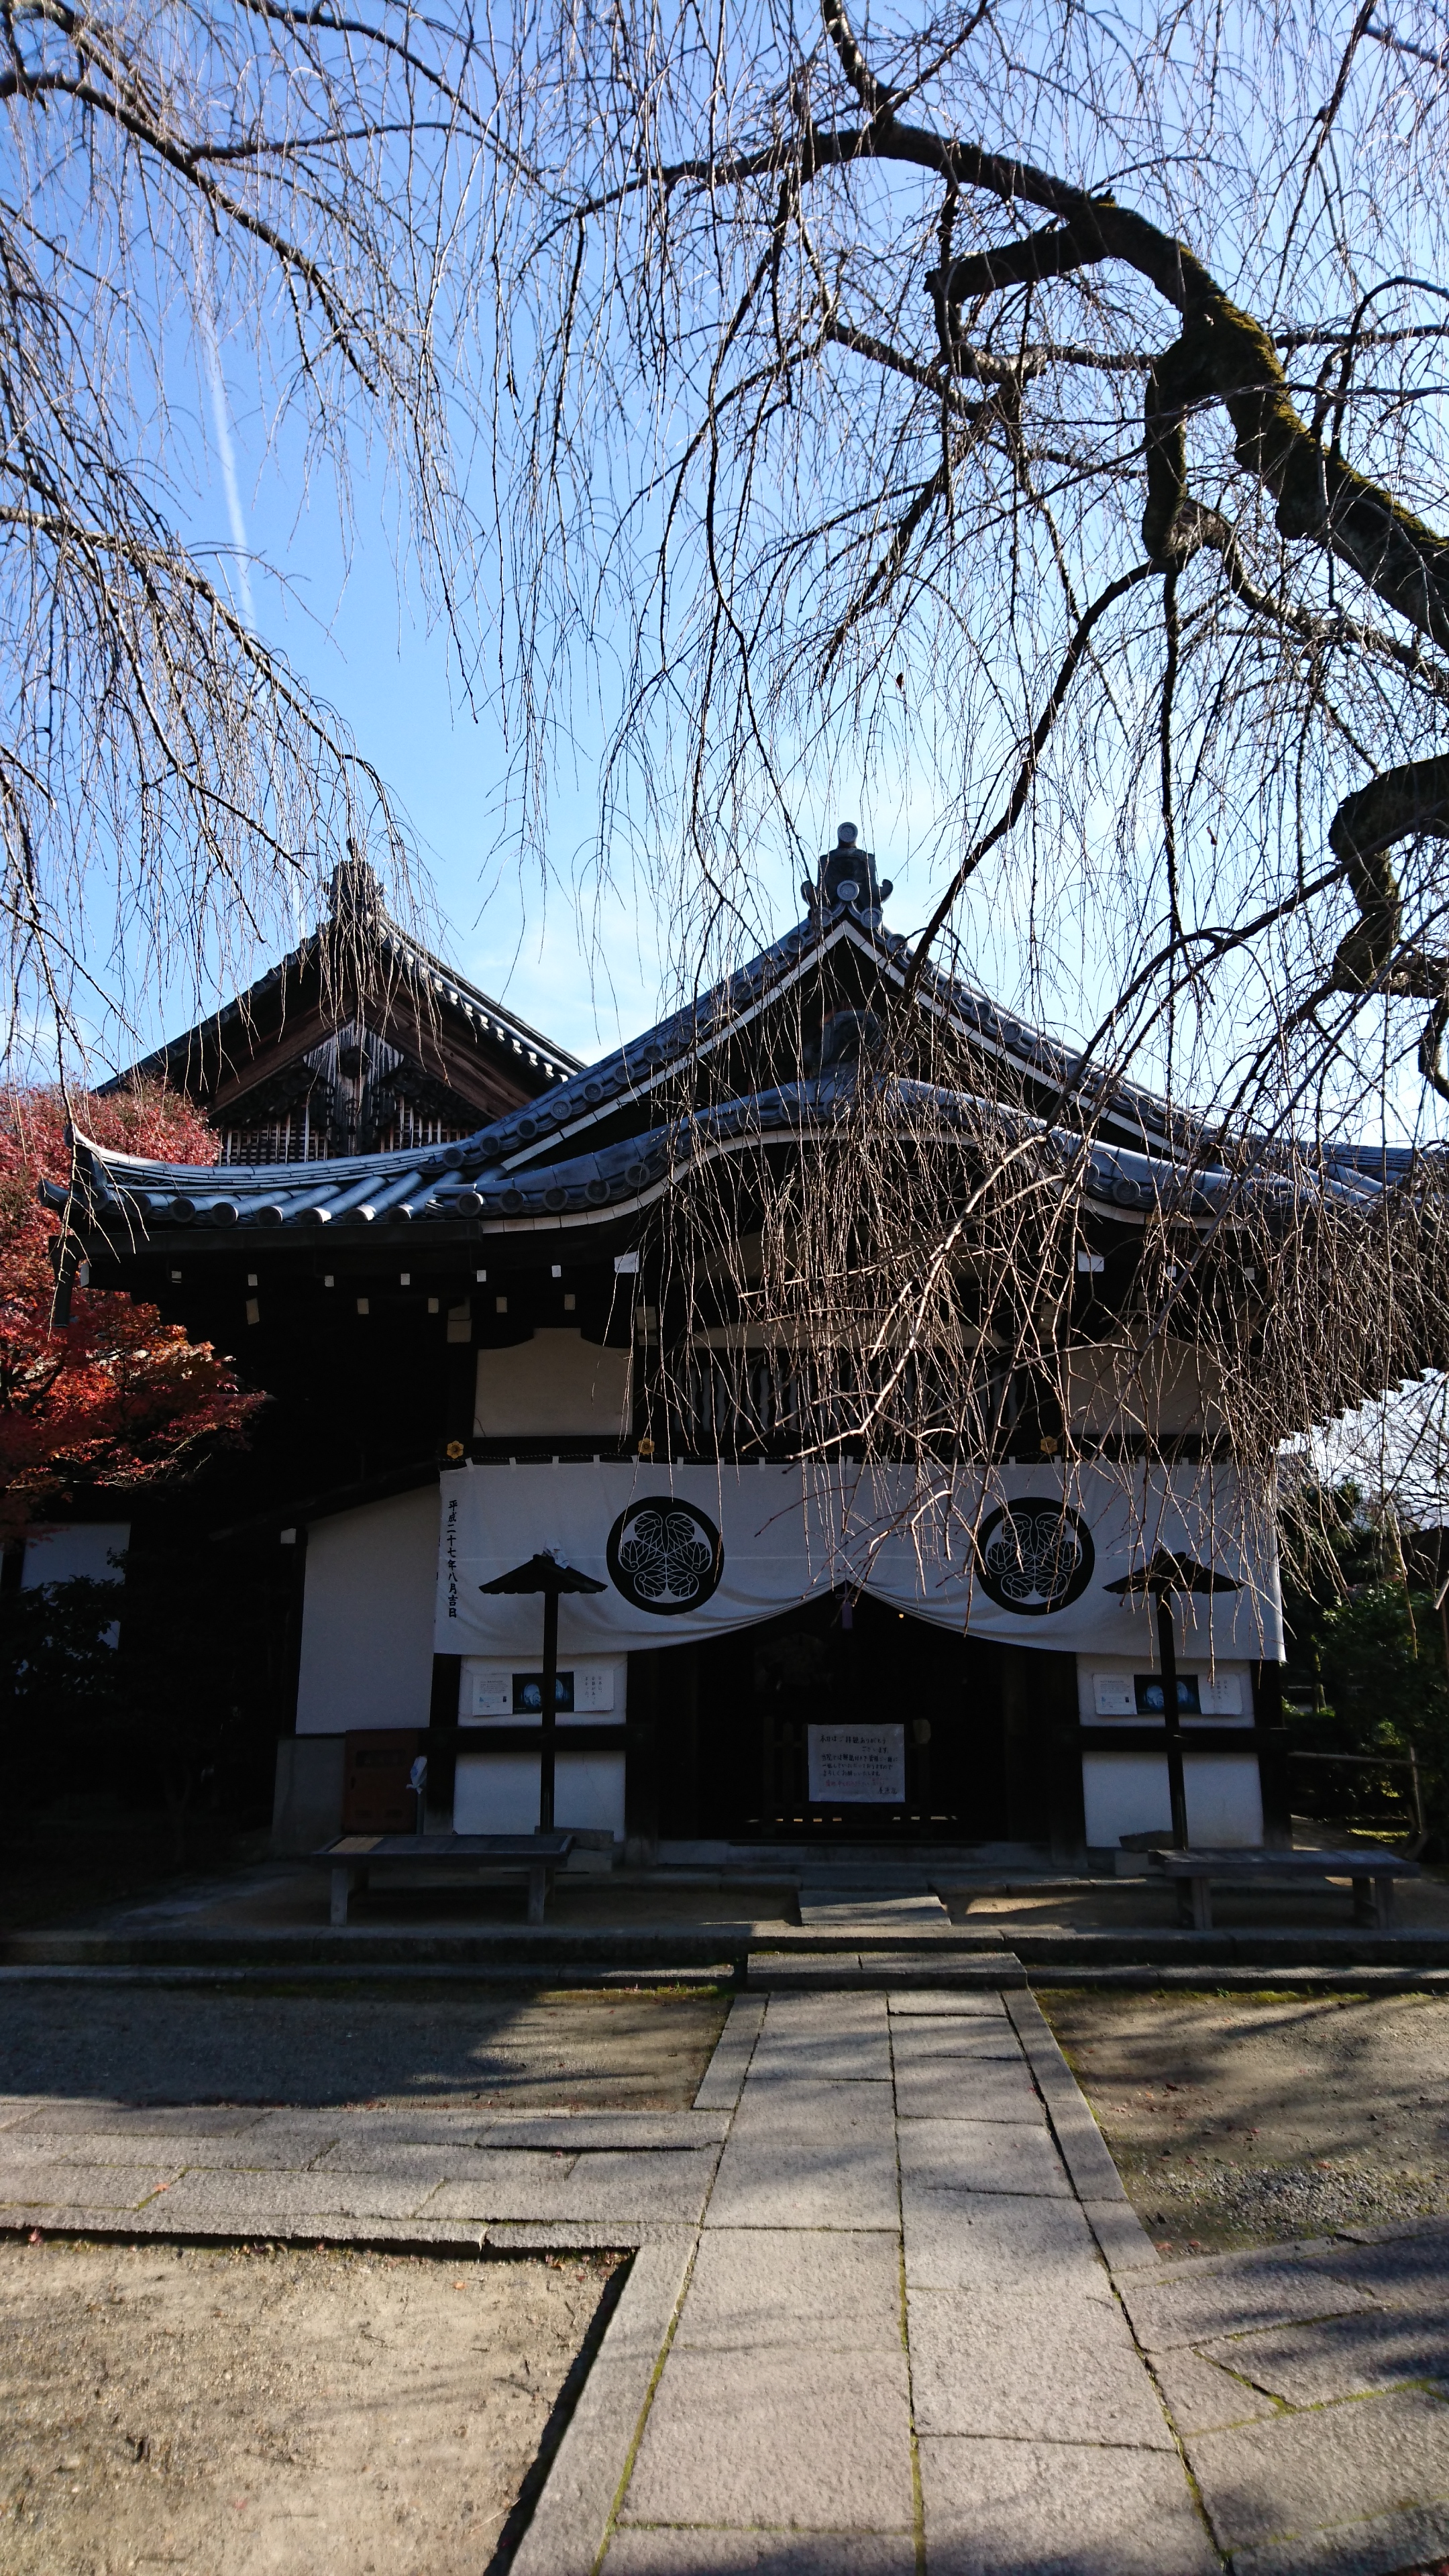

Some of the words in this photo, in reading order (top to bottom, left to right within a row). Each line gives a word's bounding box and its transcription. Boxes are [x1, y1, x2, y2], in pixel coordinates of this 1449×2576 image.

[447, 1499, 458, 1618] 平成二十七年八月吉日
